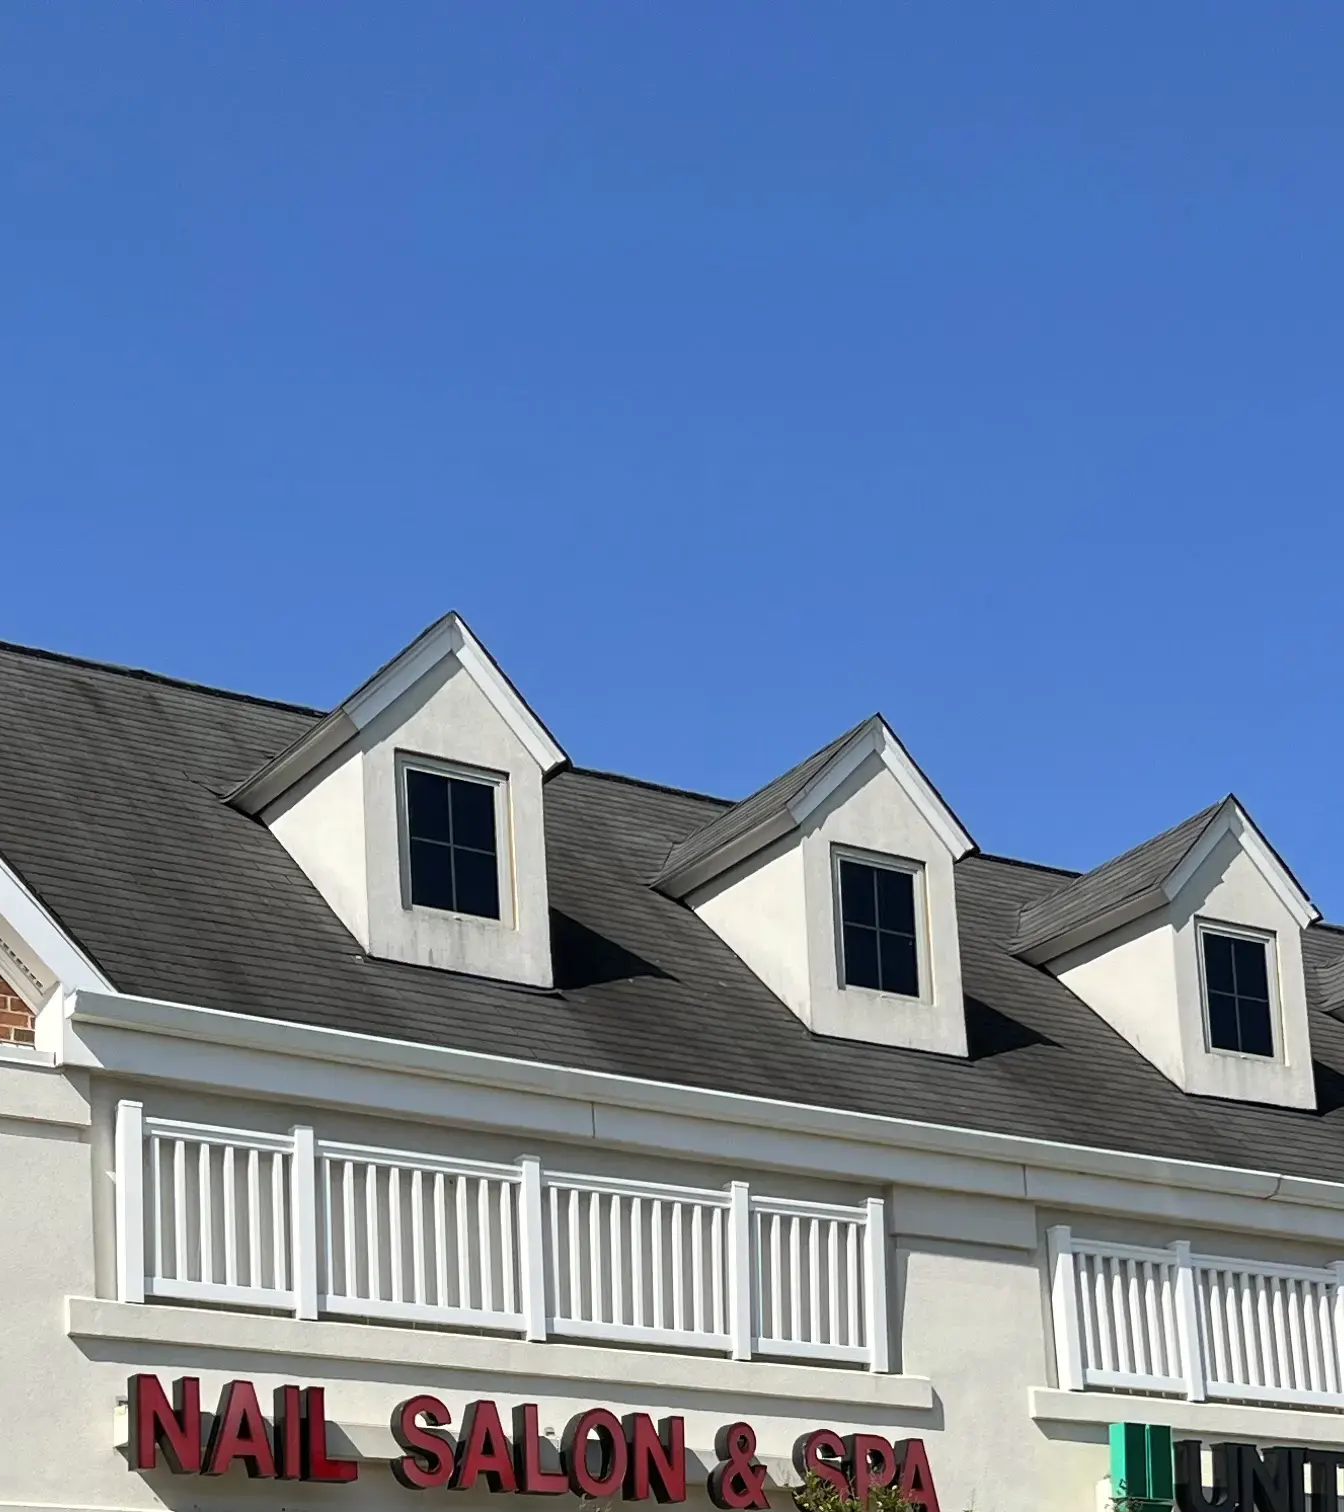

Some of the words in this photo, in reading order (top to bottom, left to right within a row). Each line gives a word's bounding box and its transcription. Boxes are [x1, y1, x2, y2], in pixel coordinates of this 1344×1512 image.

[128, 1373, 358, 1483] NAIL
[390, 1395, 687, 1503] SALON
[708, 1421, 768, 1511] &
